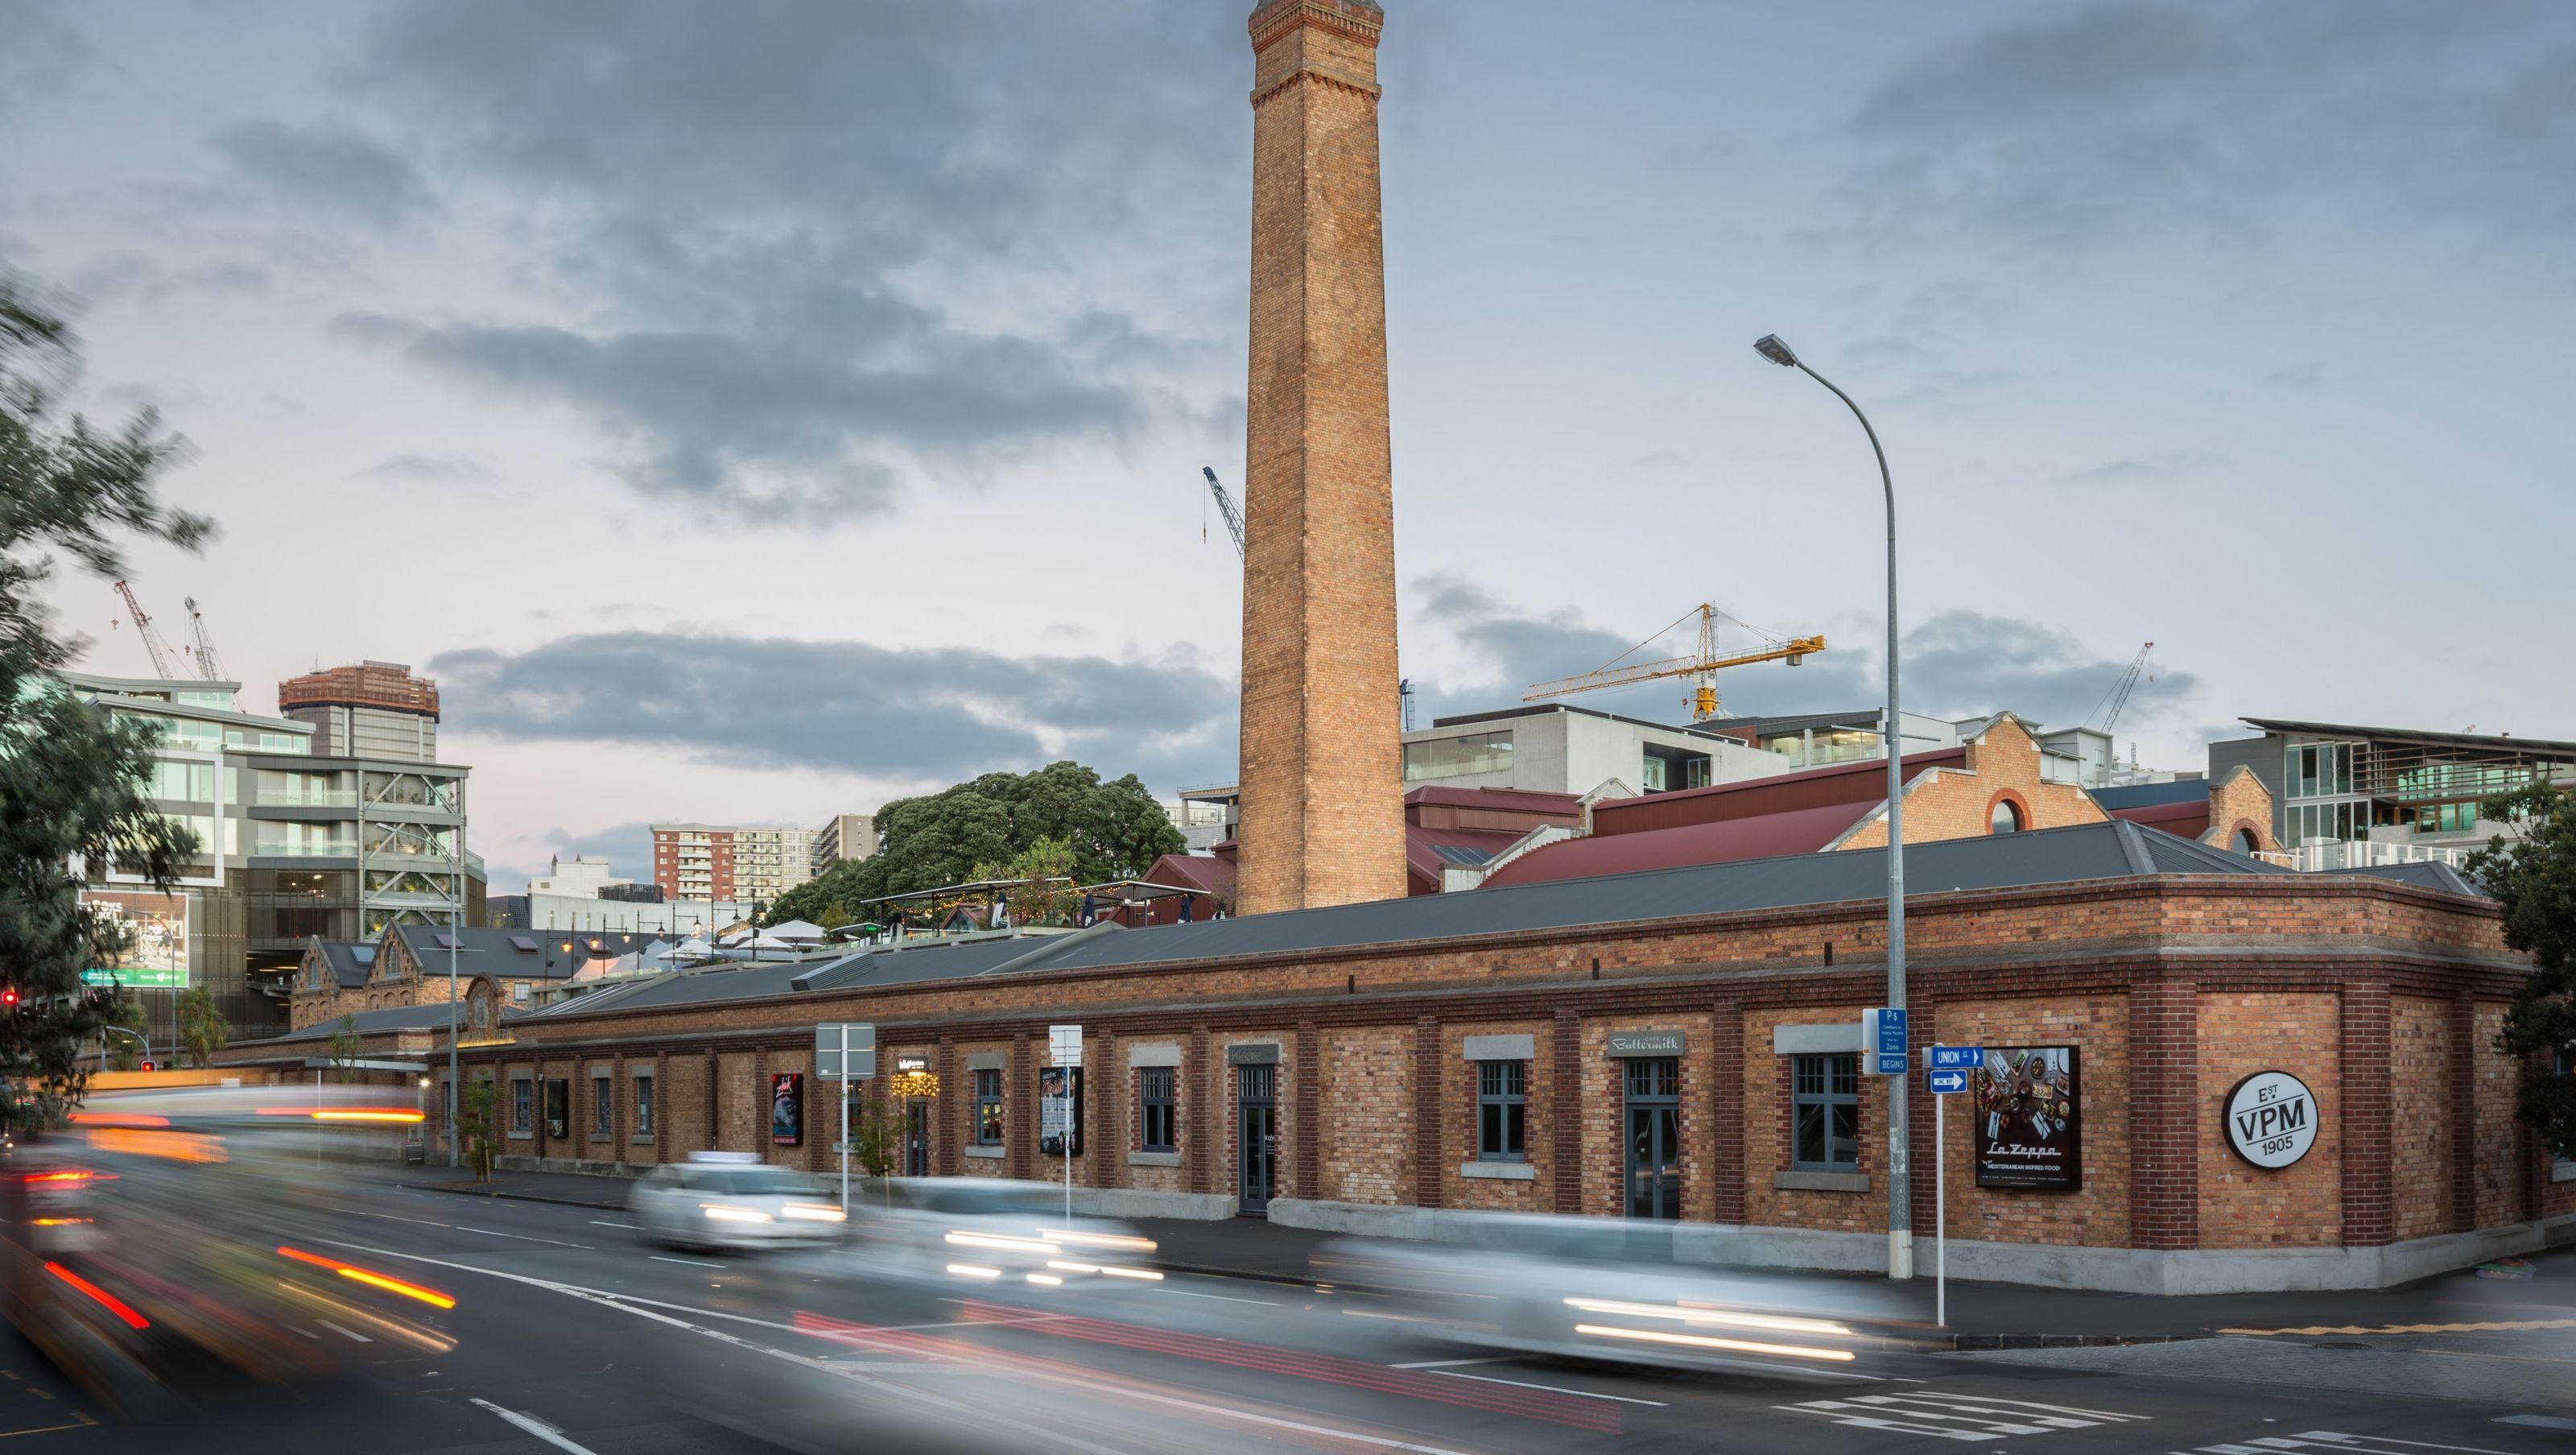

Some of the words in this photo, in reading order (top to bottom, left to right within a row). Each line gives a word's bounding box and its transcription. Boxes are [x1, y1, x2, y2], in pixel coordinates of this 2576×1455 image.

[87, 899, 122, 912] LOOKS
[1612, 1036, 1678, 1050] Buttermilk
[1882, 1060, 1904, 1069] BEGINS
[1938, 1051, 1959, 1064] UNION
[2236, 1097, 2306, 1142] VPM
[1986, 1141, 2009, 1155] La
[2009, 1143, 2062, 1159] Zeppa
[2262, 1135, 2293, 1156] 1905
